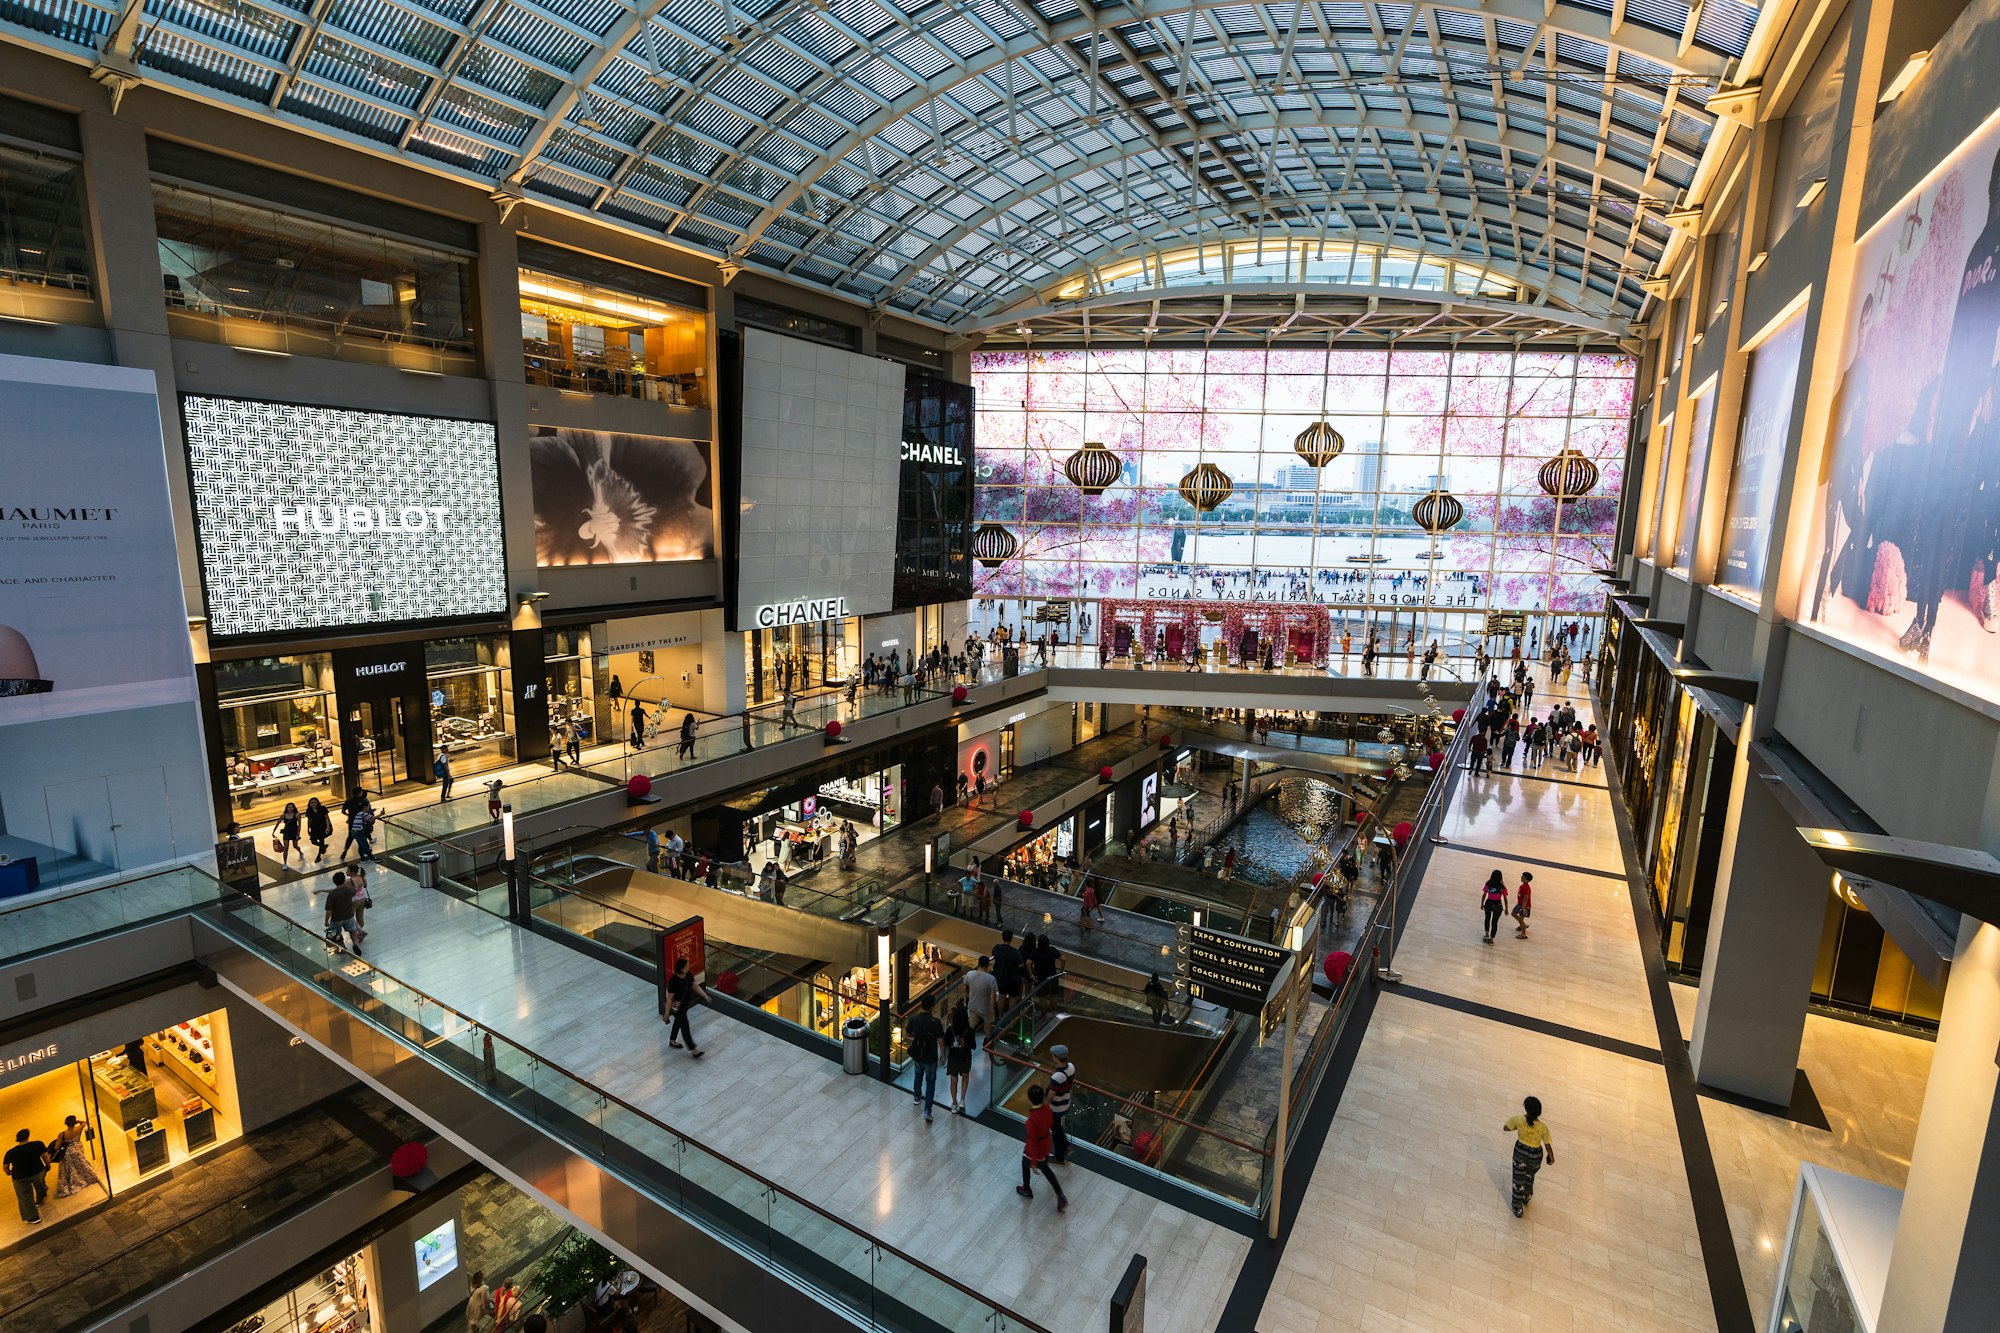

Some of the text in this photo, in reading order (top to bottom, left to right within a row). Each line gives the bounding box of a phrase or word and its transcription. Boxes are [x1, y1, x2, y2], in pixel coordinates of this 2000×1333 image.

[900, 441, 963, 466] CHANEL
[22, 522, 60, 530] PARIS
[273, 505, 449, 534] HUBLOT
[52, 575, 116, 583] CHARACTER
[758, 598, 850, 627] CHANEL
[610, 642, 645, 652] GARDENS
[355, 661, 407, 677] HUBLOT
[818, 776, 849, 793] CHANEL
[680, 945, 690, 957] 30
[1193, 930, 1281, 958] EXPO & CONVENTION
[1193, 948, 1218, 961] HOTEL
[1227, 958, 1265, 973] SKYPARK
[1192, 966, 1262, 992] COACH TERMINAL
